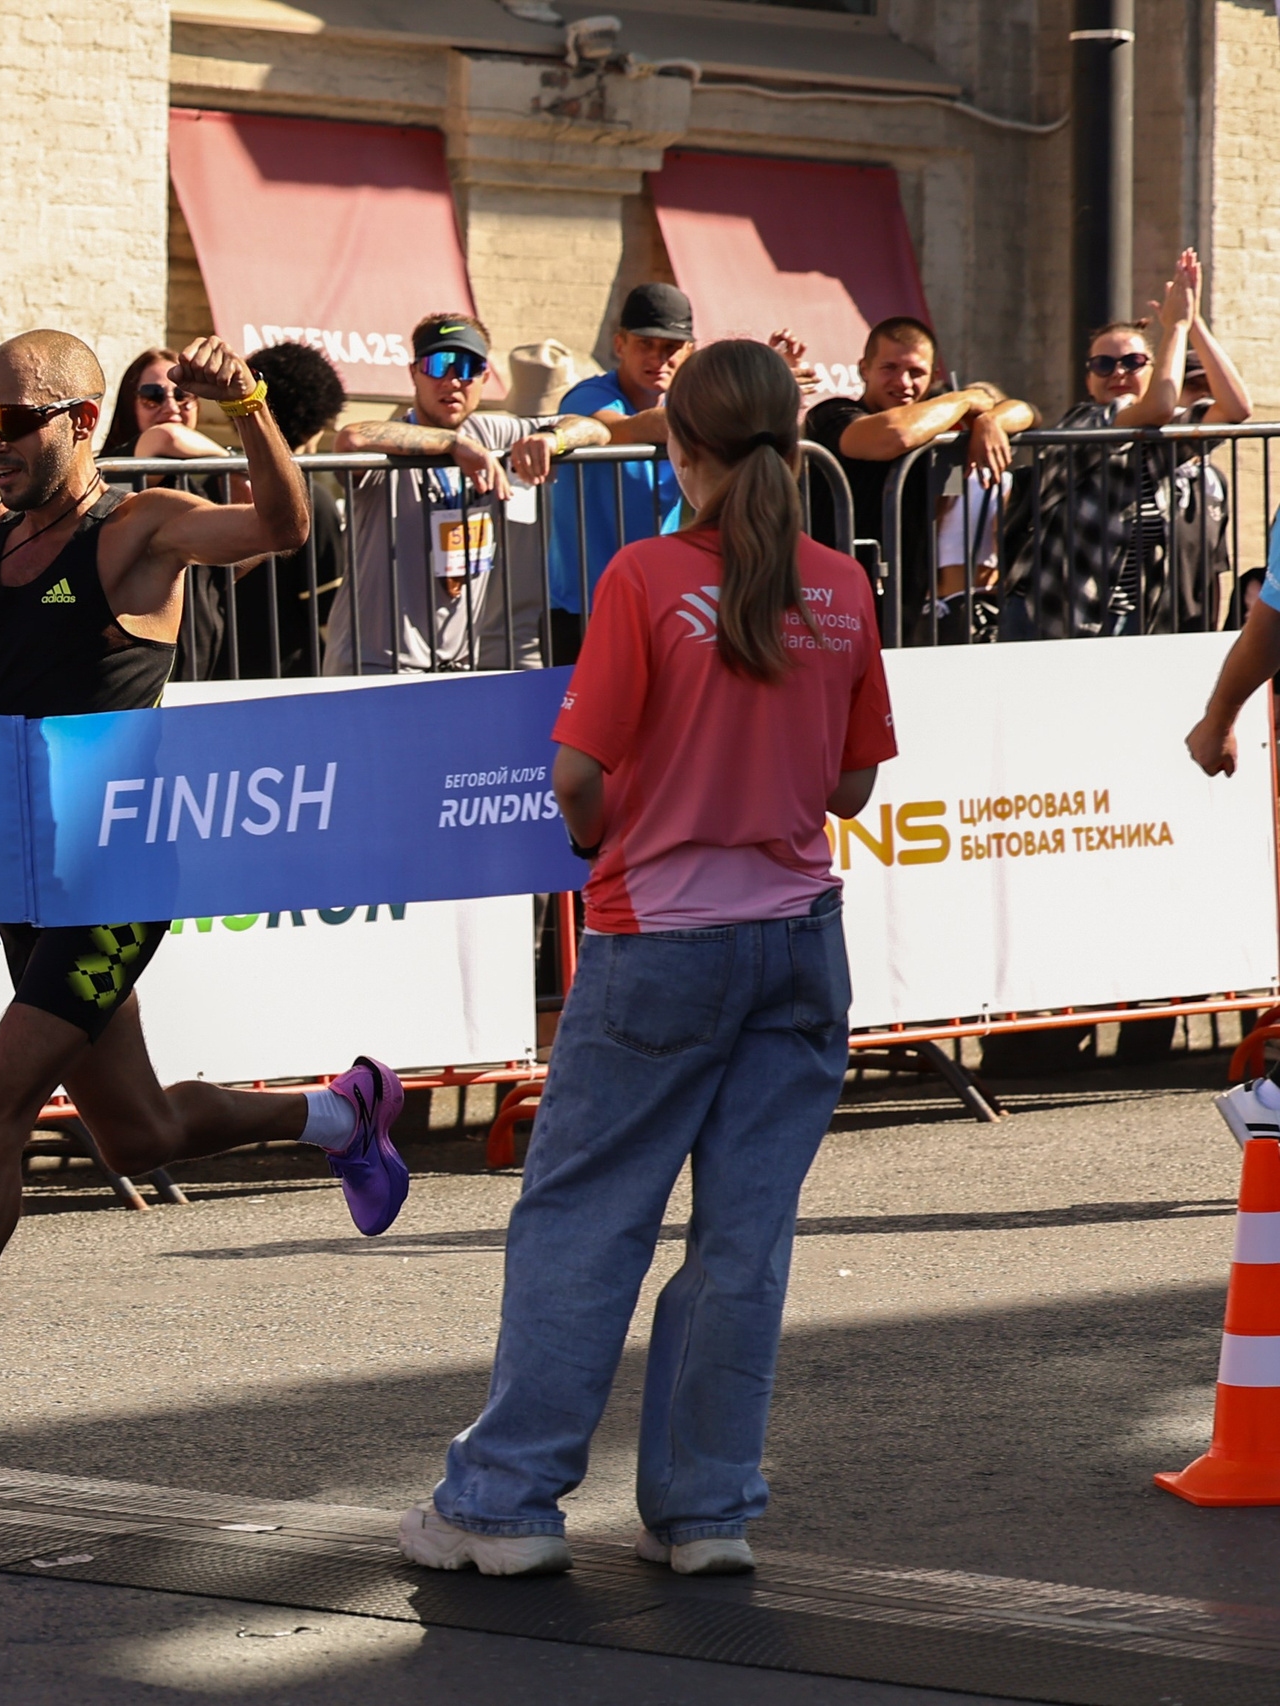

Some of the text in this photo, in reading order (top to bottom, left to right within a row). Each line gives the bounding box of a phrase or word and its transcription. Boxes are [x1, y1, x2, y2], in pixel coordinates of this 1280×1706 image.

[41, 594, 76, 604] adidas
[801, 587, 833, 607] axy
[445, 766, 546, 789] БЕГОВОЙ КЛУБ
[98, 762, 337, 847] FINISH
[438, 789, 564, 828] RUNDNS
[958, 789, 1110, 827] ЦИФРОВАЯ И
[822, 800, 951, 870] NS
[960, 820, 1174, 862] БЫТОВАЯ ТЕХНИКА
